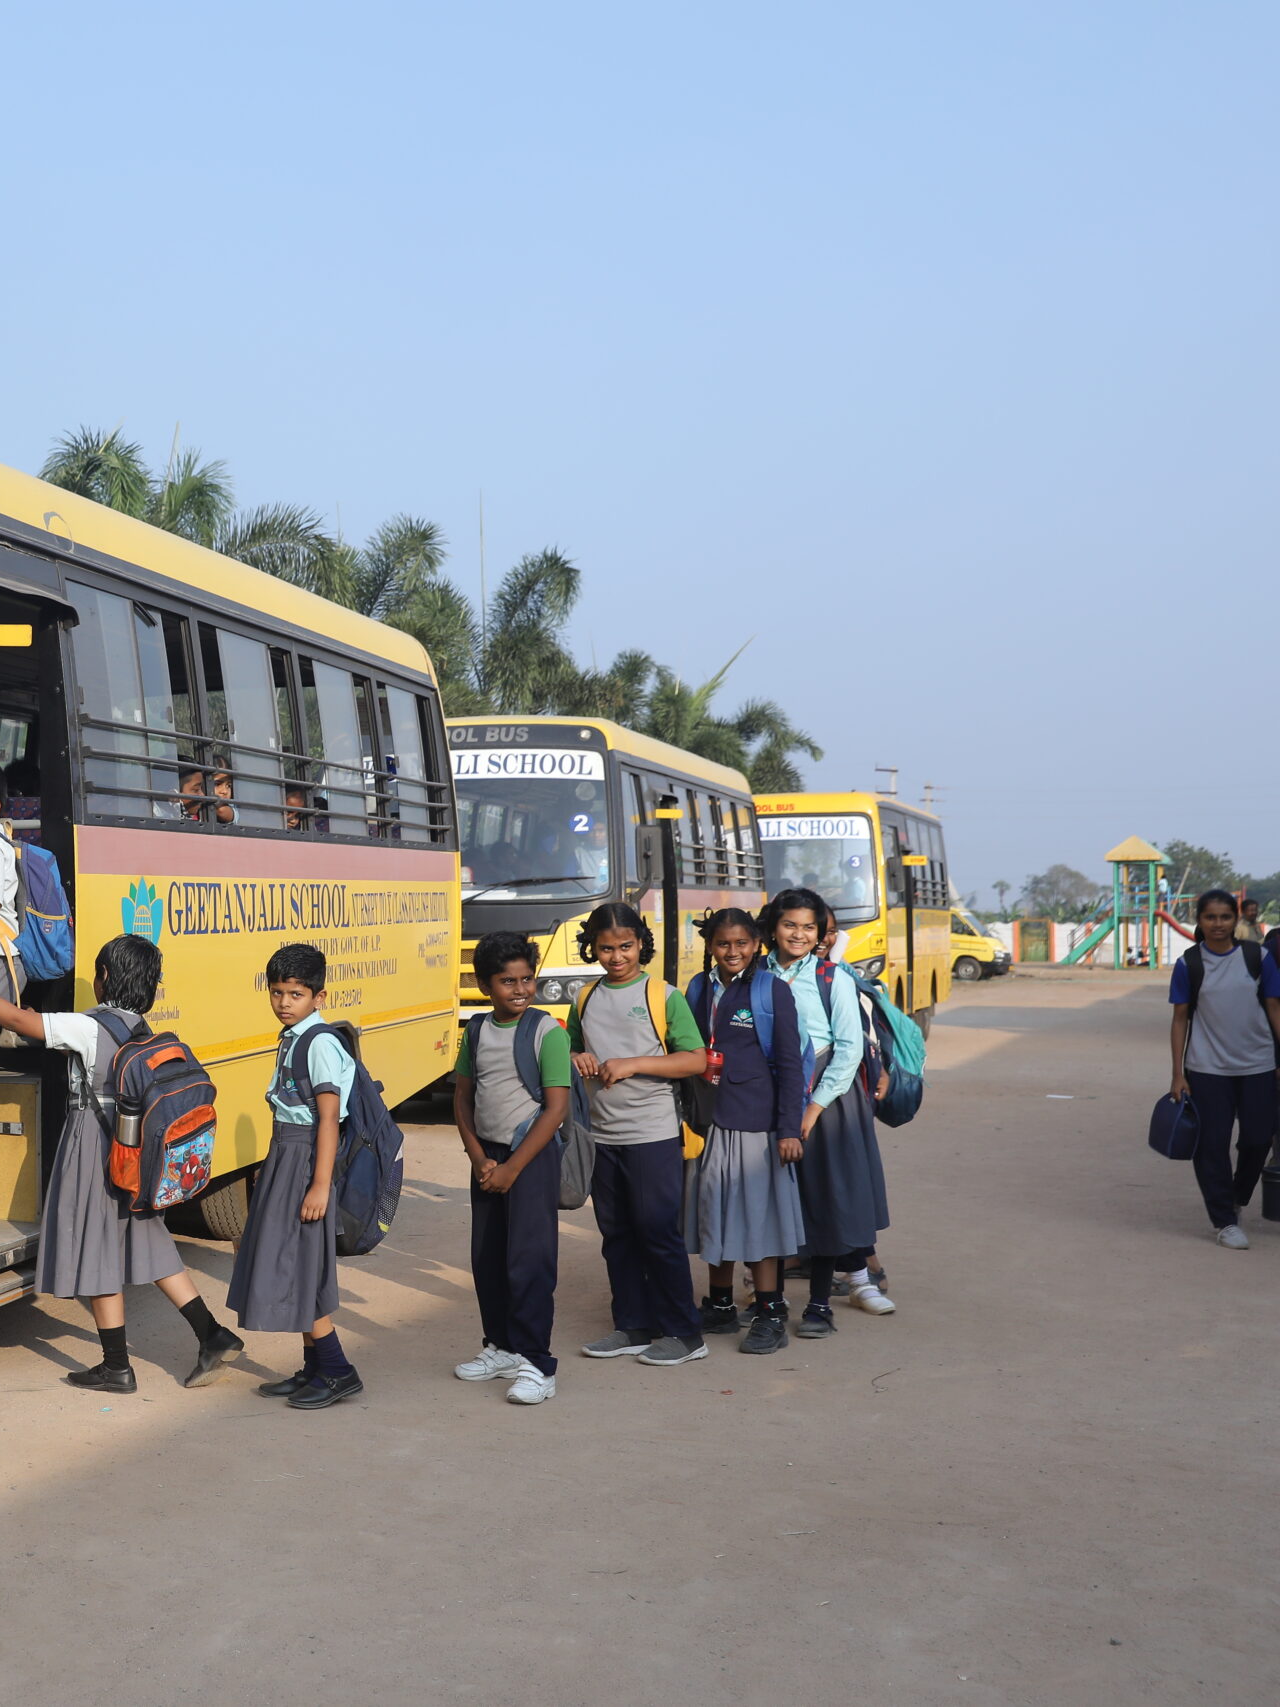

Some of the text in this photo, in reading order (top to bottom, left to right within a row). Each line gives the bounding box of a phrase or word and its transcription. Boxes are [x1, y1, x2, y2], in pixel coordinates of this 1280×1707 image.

[447, 726, 529, 743] OL BUS
[454, 753, 593, 776] LI SCHOOL
[776, 803, 795, 811] BUS
[573, 814, 590, 832] 2
[786, 819, 860, 838] SCHOOL
[851, 856, 861, 867] 3
[167, 881, 287, 936] GEETANJALI
[290, 882, 350, 930] SCHOOL
[331, 938, 339, 955] BY
[341, 936, 359, 954] GOVT.
[361, 935, 370, 952] OF
